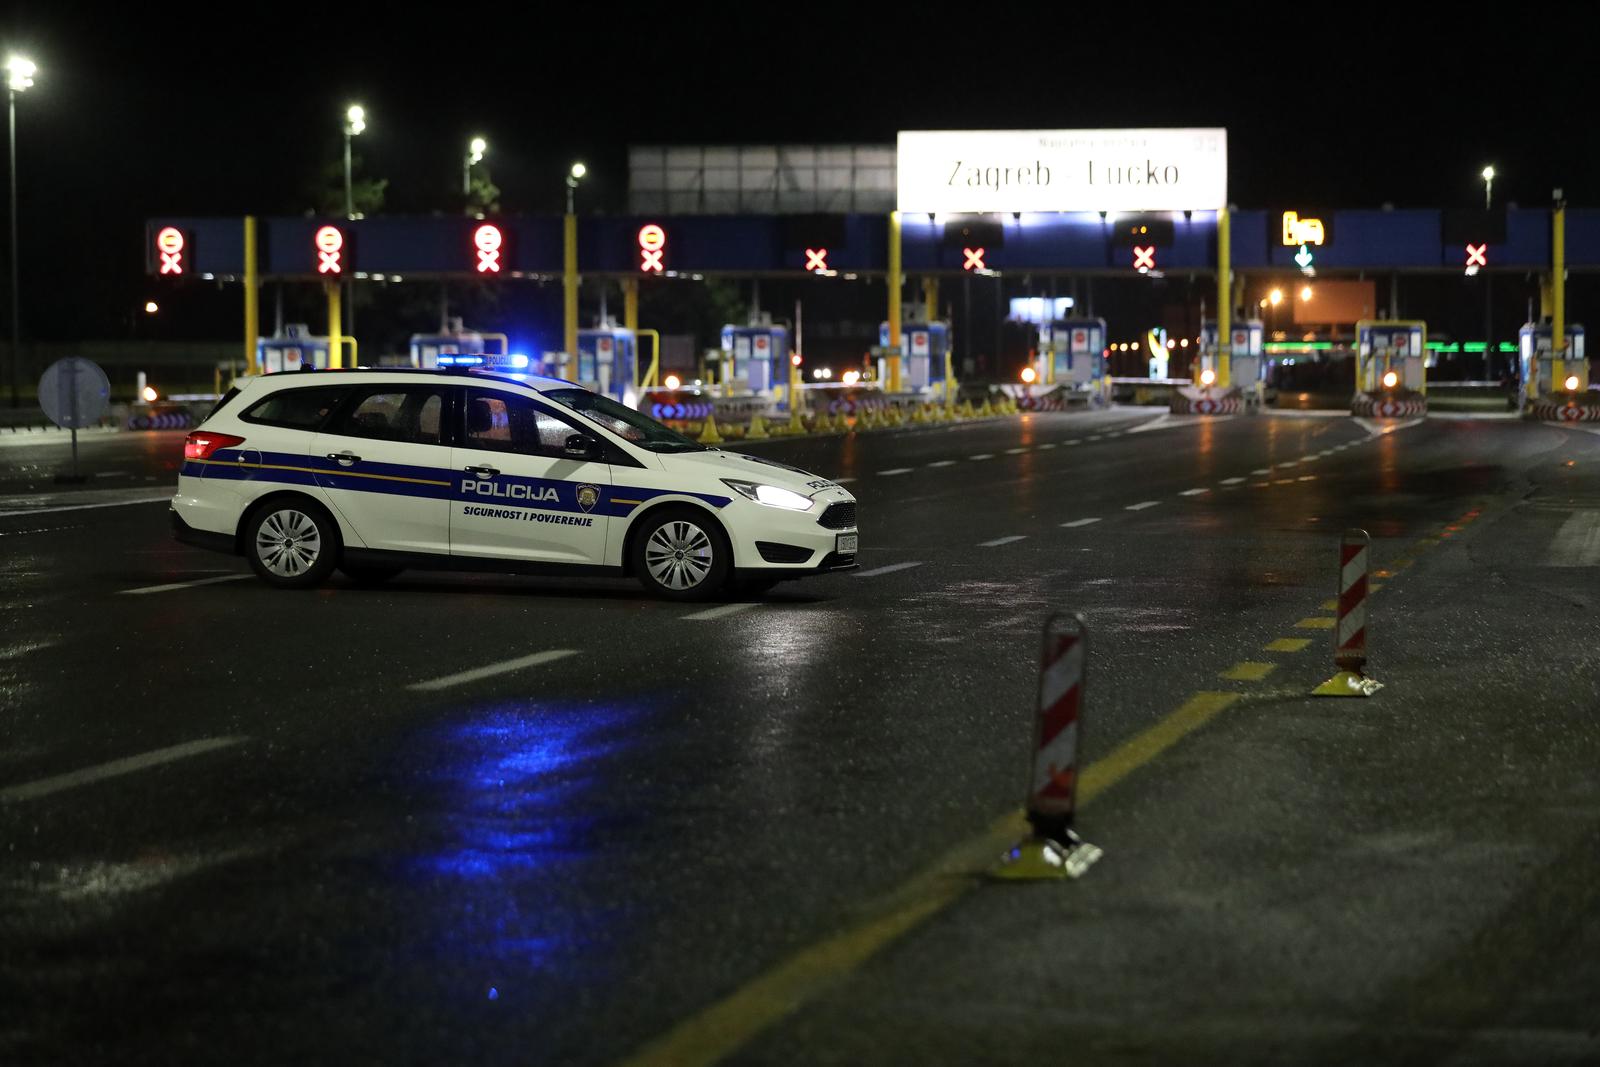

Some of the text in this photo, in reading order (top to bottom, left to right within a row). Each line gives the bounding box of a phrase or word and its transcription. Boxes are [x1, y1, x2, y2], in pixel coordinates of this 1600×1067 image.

[948, 160, 1052, 191] Zagreb
[461, 479, 560, 503] POLICIJA
[463, 506, 593, 527] SIGURNOST I POVJERENJE
